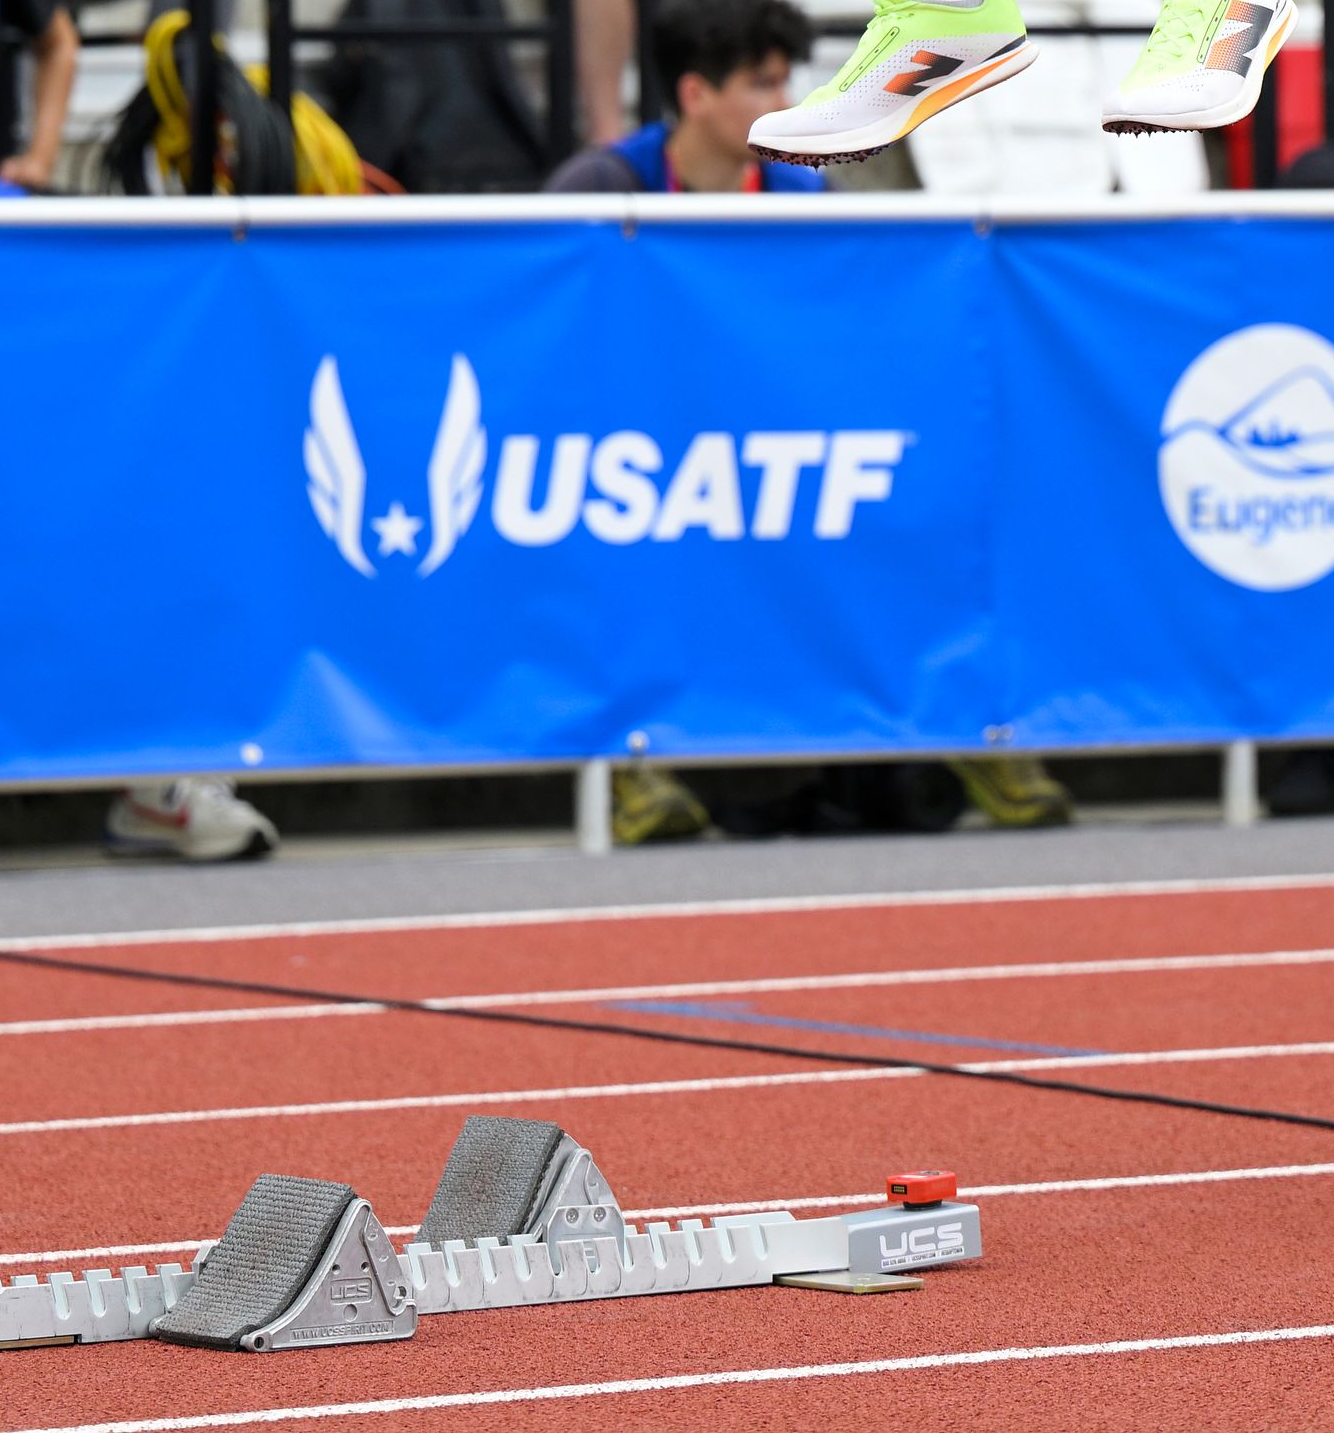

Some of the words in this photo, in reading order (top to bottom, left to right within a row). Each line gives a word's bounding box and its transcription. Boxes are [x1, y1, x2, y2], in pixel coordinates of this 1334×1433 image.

[491, 429, 905, 548] USATF
[879, 1222, 964, 1258] UCS
[331, 1282, 370, 1301] UCS
